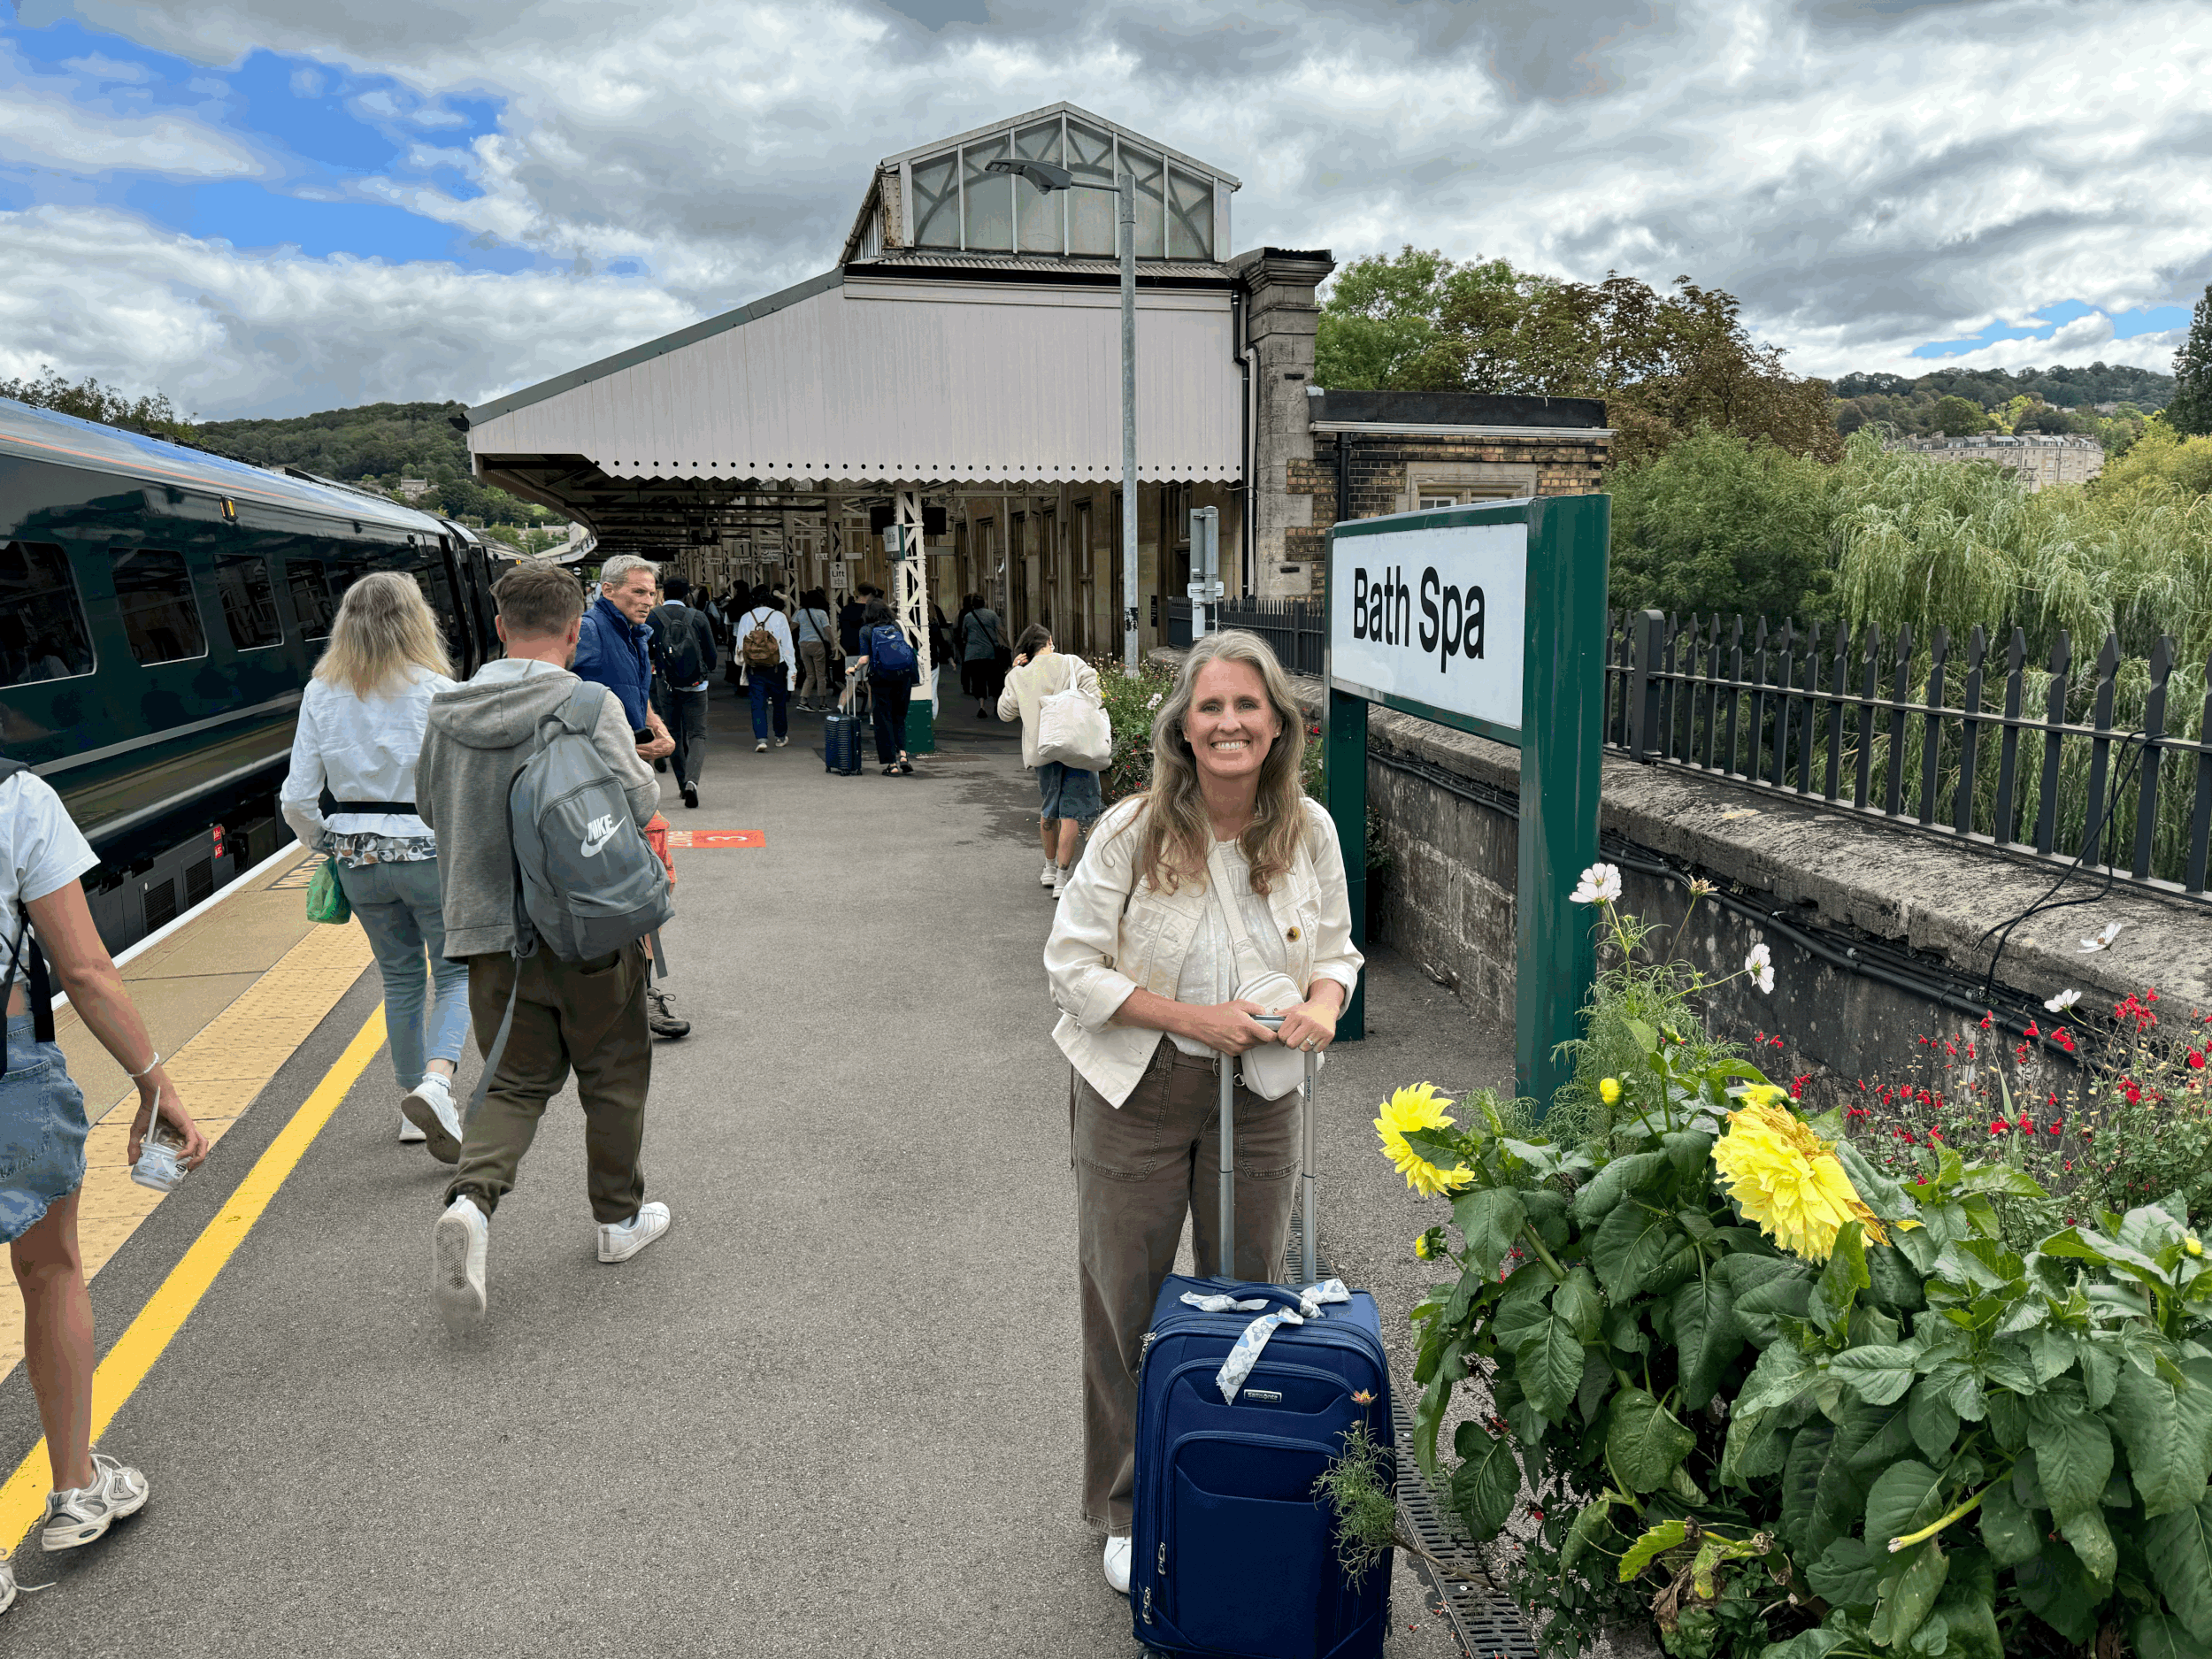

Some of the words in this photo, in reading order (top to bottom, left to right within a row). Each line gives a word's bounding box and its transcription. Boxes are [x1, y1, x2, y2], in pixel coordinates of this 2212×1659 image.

[739, 544, 744, 555] 1
[1353, 565, 1410, 647] Bath
[1418, 566, 1485, 673] Spa
[587, 813, 613, 842] NIKE
